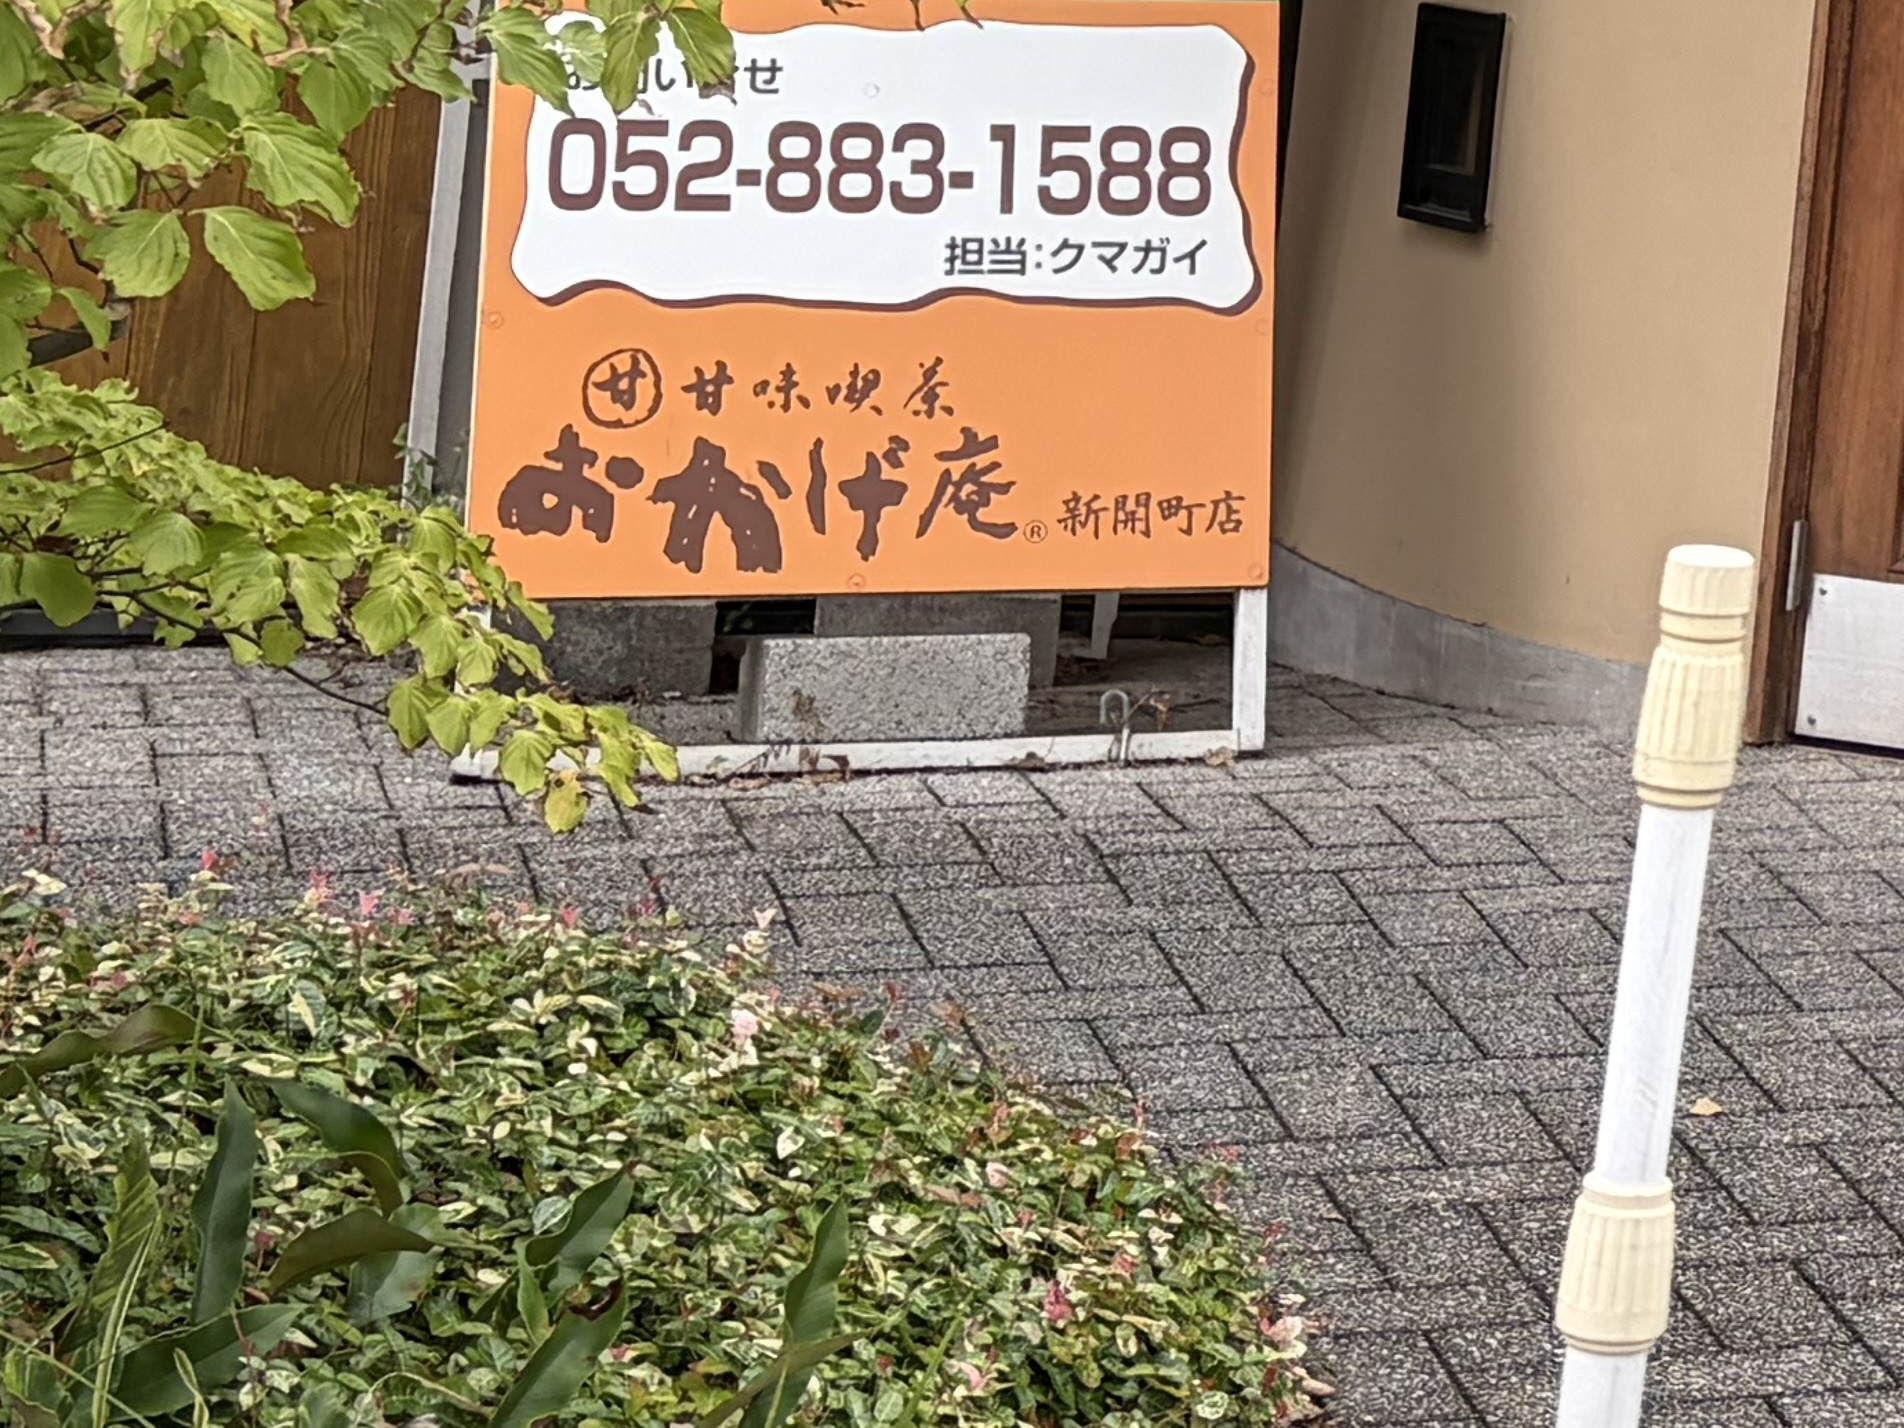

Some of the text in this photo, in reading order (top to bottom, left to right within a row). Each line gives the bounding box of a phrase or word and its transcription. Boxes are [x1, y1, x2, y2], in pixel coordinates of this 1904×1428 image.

[547, 118, 1213, 217] 052-883-1588
[943, 236, 1208, 277] 担当:クマガイ
[680, 355, 957, 420] 甘味喫茶
[1060, 490, 1247, 538] 新開町店
